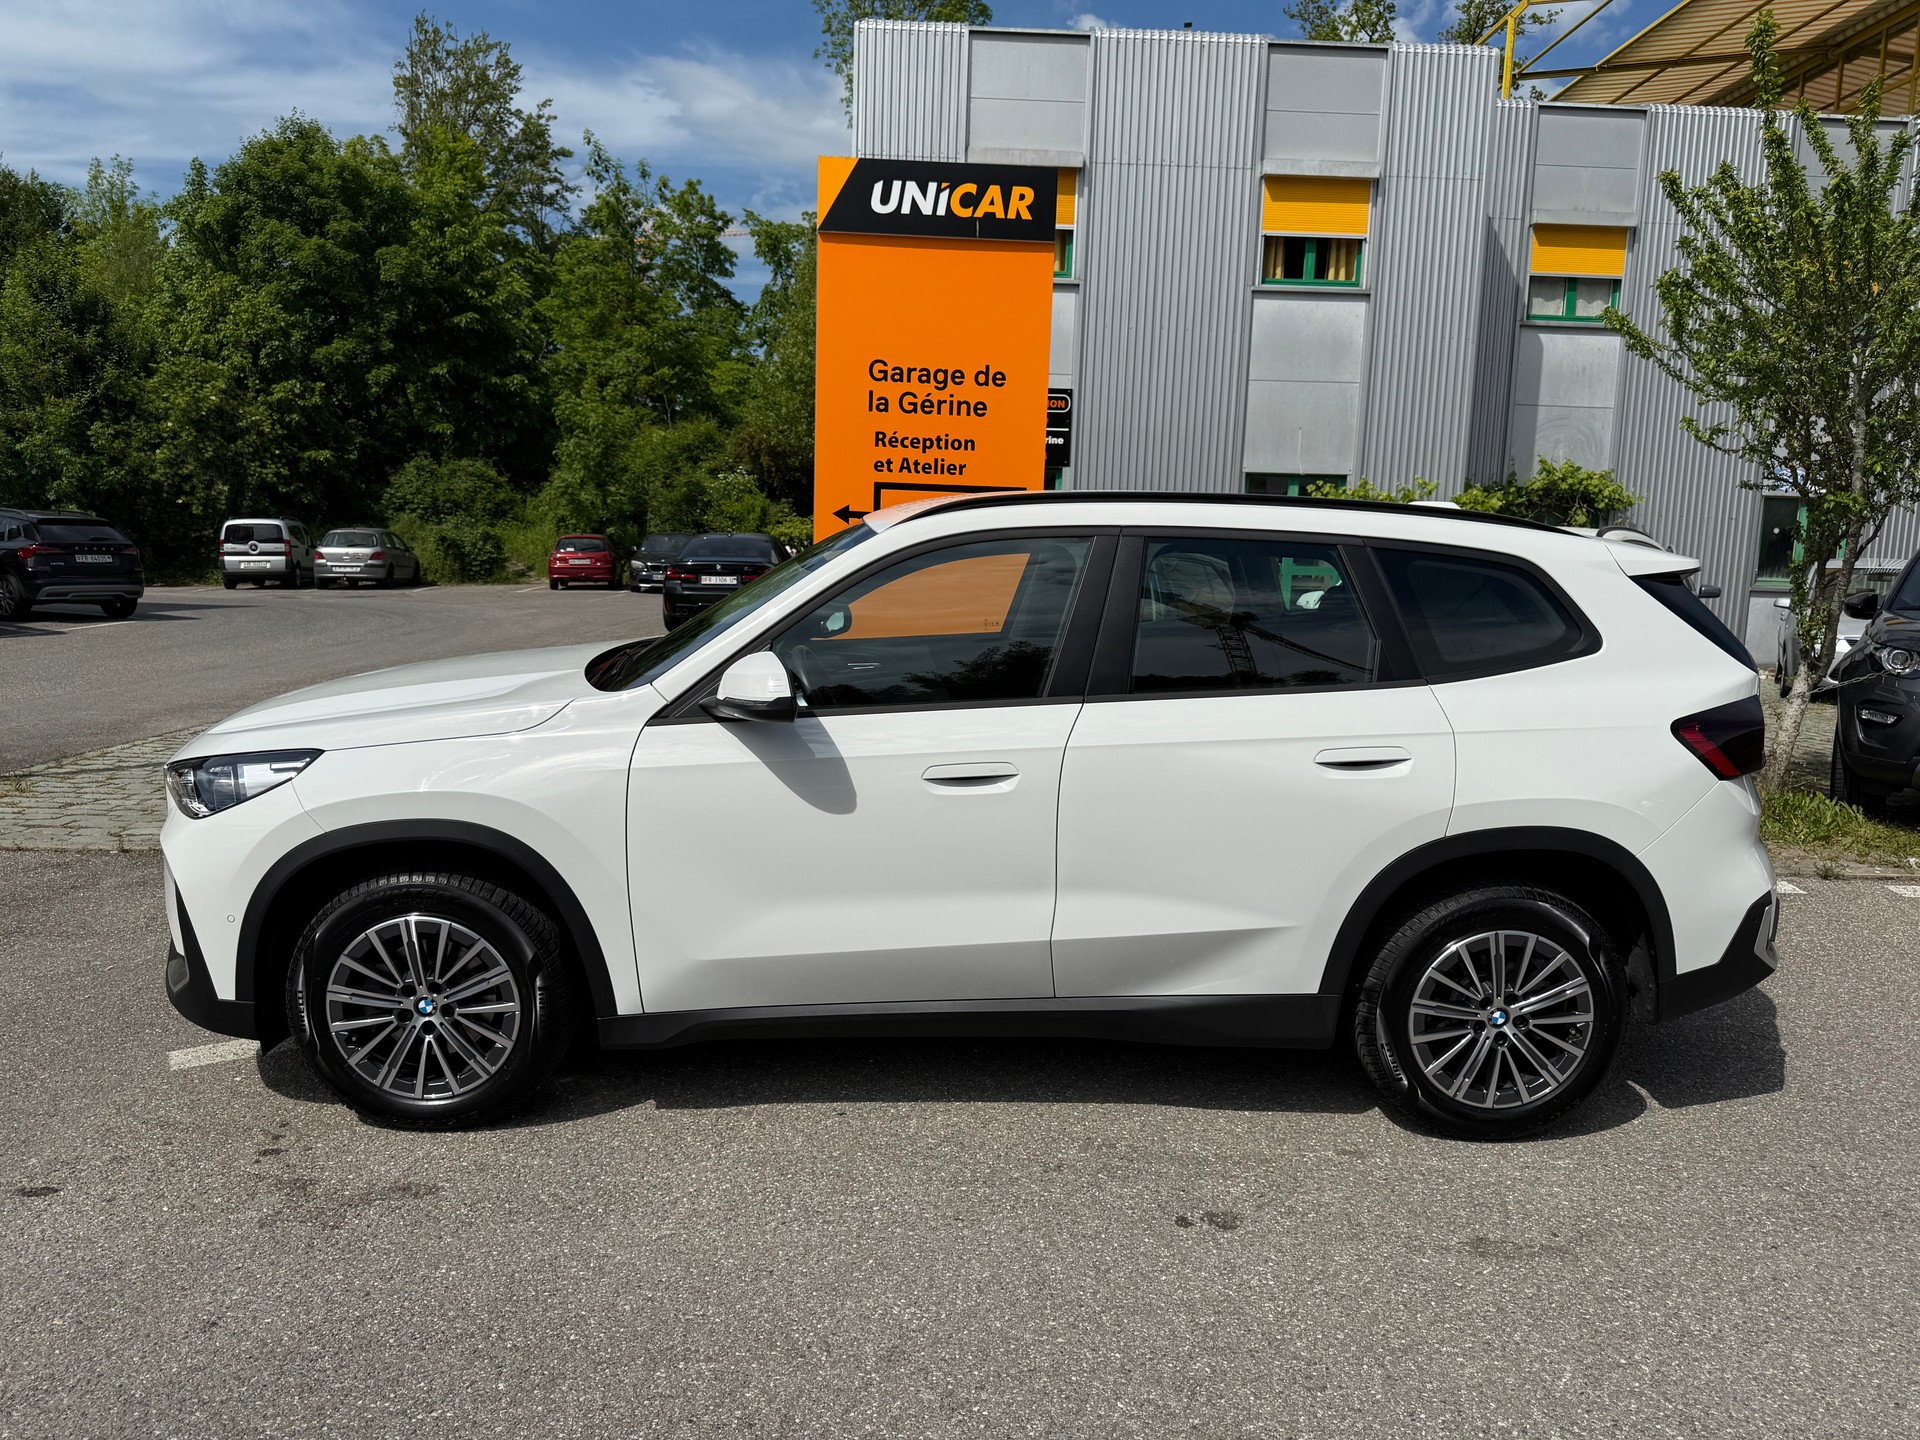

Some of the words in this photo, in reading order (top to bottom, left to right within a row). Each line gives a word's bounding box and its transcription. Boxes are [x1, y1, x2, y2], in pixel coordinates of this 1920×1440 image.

[868, 359, 966, 391] Garage
[974, 364, 1007, 388] de
[868, 390, 889, 413] la
[898, 391, 988, 417] Gérine
[874, 431, 976, 454] Réception
[873, 457, 894, 473] et
[898, 457, 967, 476] Atelier
